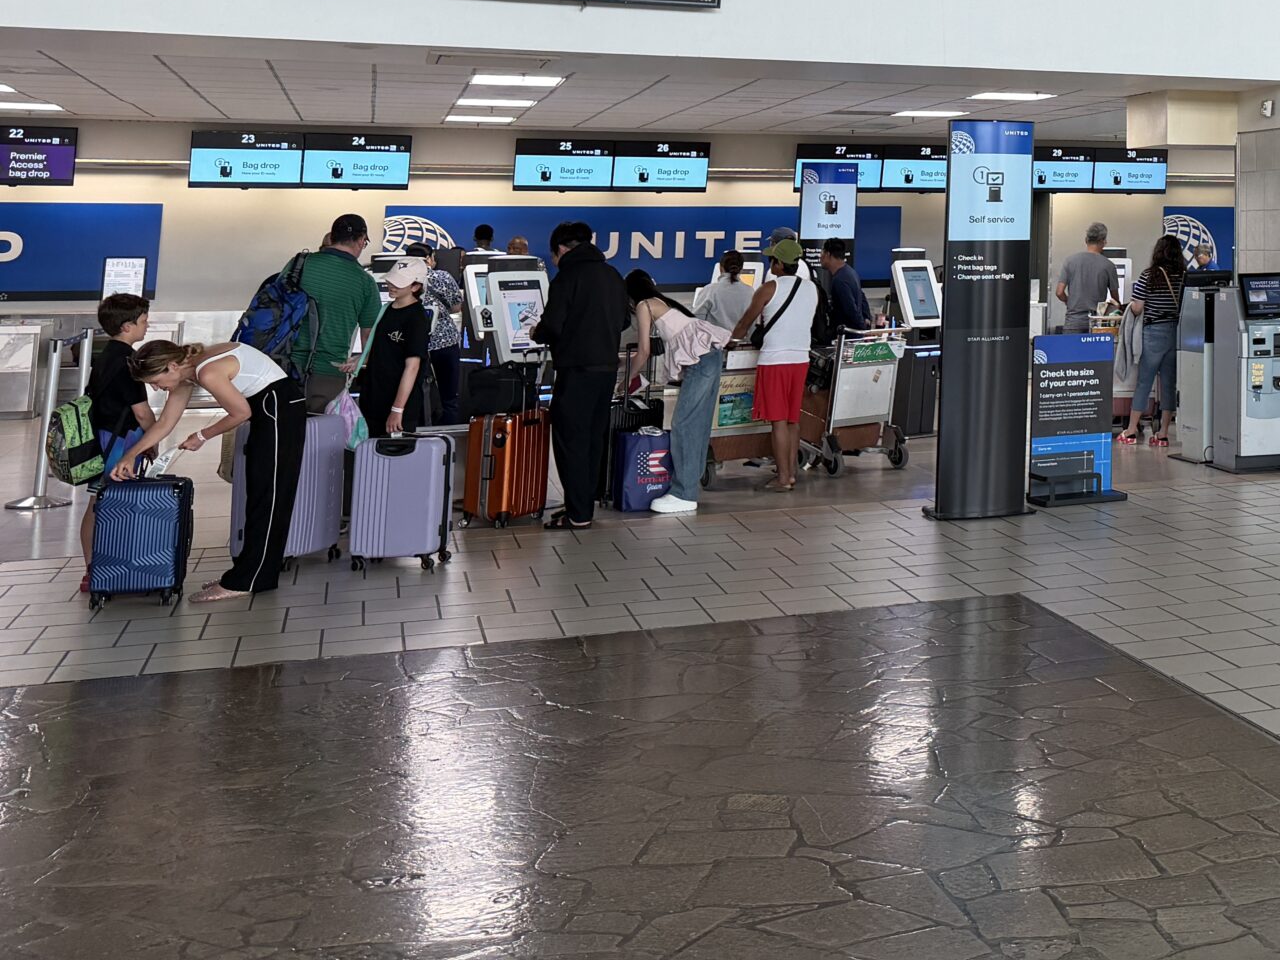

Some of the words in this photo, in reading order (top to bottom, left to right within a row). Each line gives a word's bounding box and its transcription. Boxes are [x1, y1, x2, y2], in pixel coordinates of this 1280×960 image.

[9, 129, 24, 138] 22
[241, 134, 256, 144] 23
[352, 136, 366, 146] 24
[560, 142, 572, 150] 25
[656, 144, 670, 152] 26
[835, 146, 846, 154] 27
[10, 152, 47, 160] Premier
[920, 148, 932, 156] 28
[1052, 149, 1062, 157] 29
[242, 162, 258, 170] Bag
[260, 162, 280, 170] drop
[352, 163, 368, 172] Bag
[370, 163, 388, 172] drop
[8, 169, 26, 178] bag
[28, 170, 50, 179] drop
[560, 167, 574, 175] Bag
[576, 167, 594, 175] drop
[657, 168, 672, 176] Bag
[672, 168, 690, 176] drop
[968, 216, 986, 224] Self
[986, 216, 1014, 224] service
[830, 222, 842, 230] drop
[590, 230, 798, 260] UNITE
[972, 264, 984, 272] bag
[1040, 369, 1065, 378] Check
[1066, 368, 1078, 376] the
[1080, 368, 1094, 376] size
[1040, 380, 1048, 388] of
[1049, 380, 1066, 389] your
[1067, 378, 1100, 387] carry-on
[638, 476, 672, 484] kmart
[646, 484, 662, 493] Guam
